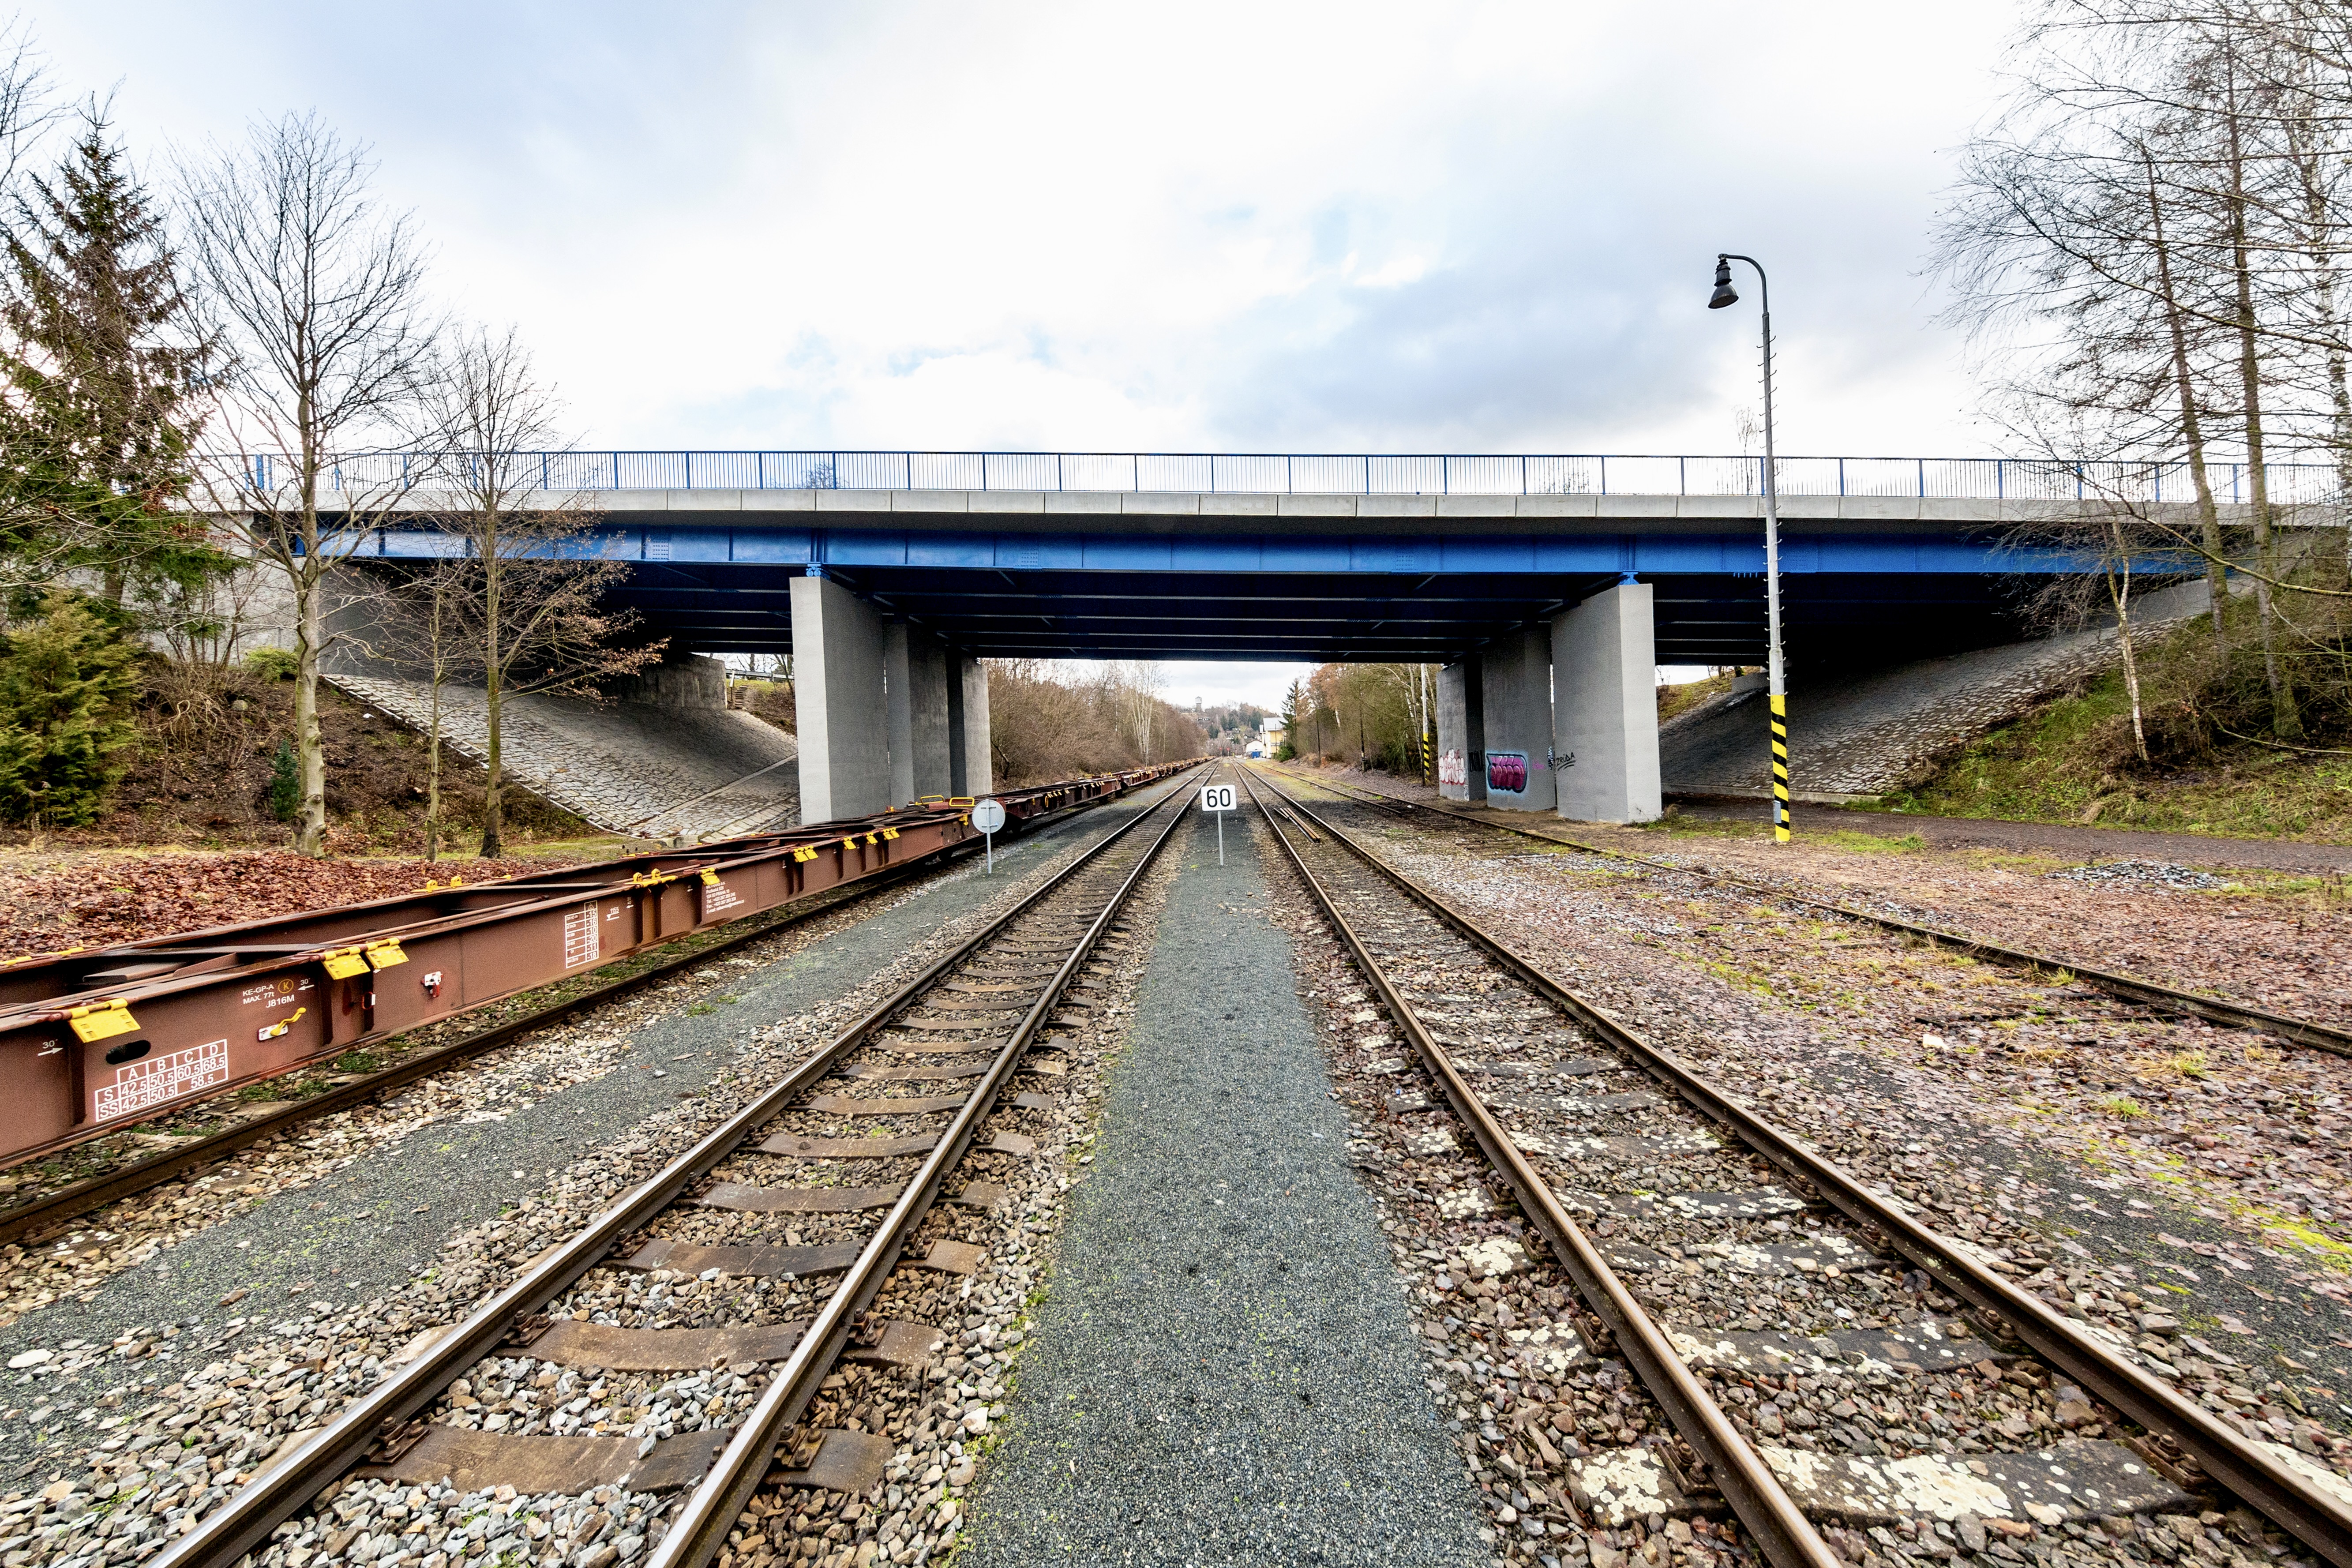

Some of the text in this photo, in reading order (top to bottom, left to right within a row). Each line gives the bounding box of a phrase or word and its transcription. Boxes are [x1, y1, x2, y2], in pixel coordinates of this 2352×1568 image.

[1207, 788, 1230, 807] 60
[587, 934, 597, 943] -20
[243, 984, 274, 997] KE-GP-A
[243, 995, 262, 1004] MAX.
[266, 994, 295, 1008] J816M
[128, 1044, 218, 1080] A B C D
[104, 1056, 225, 1102] S 42.5 50.5 60.5 68.5
[100, 1073, 214, 1118] SS 42.5 50.5 58.5
